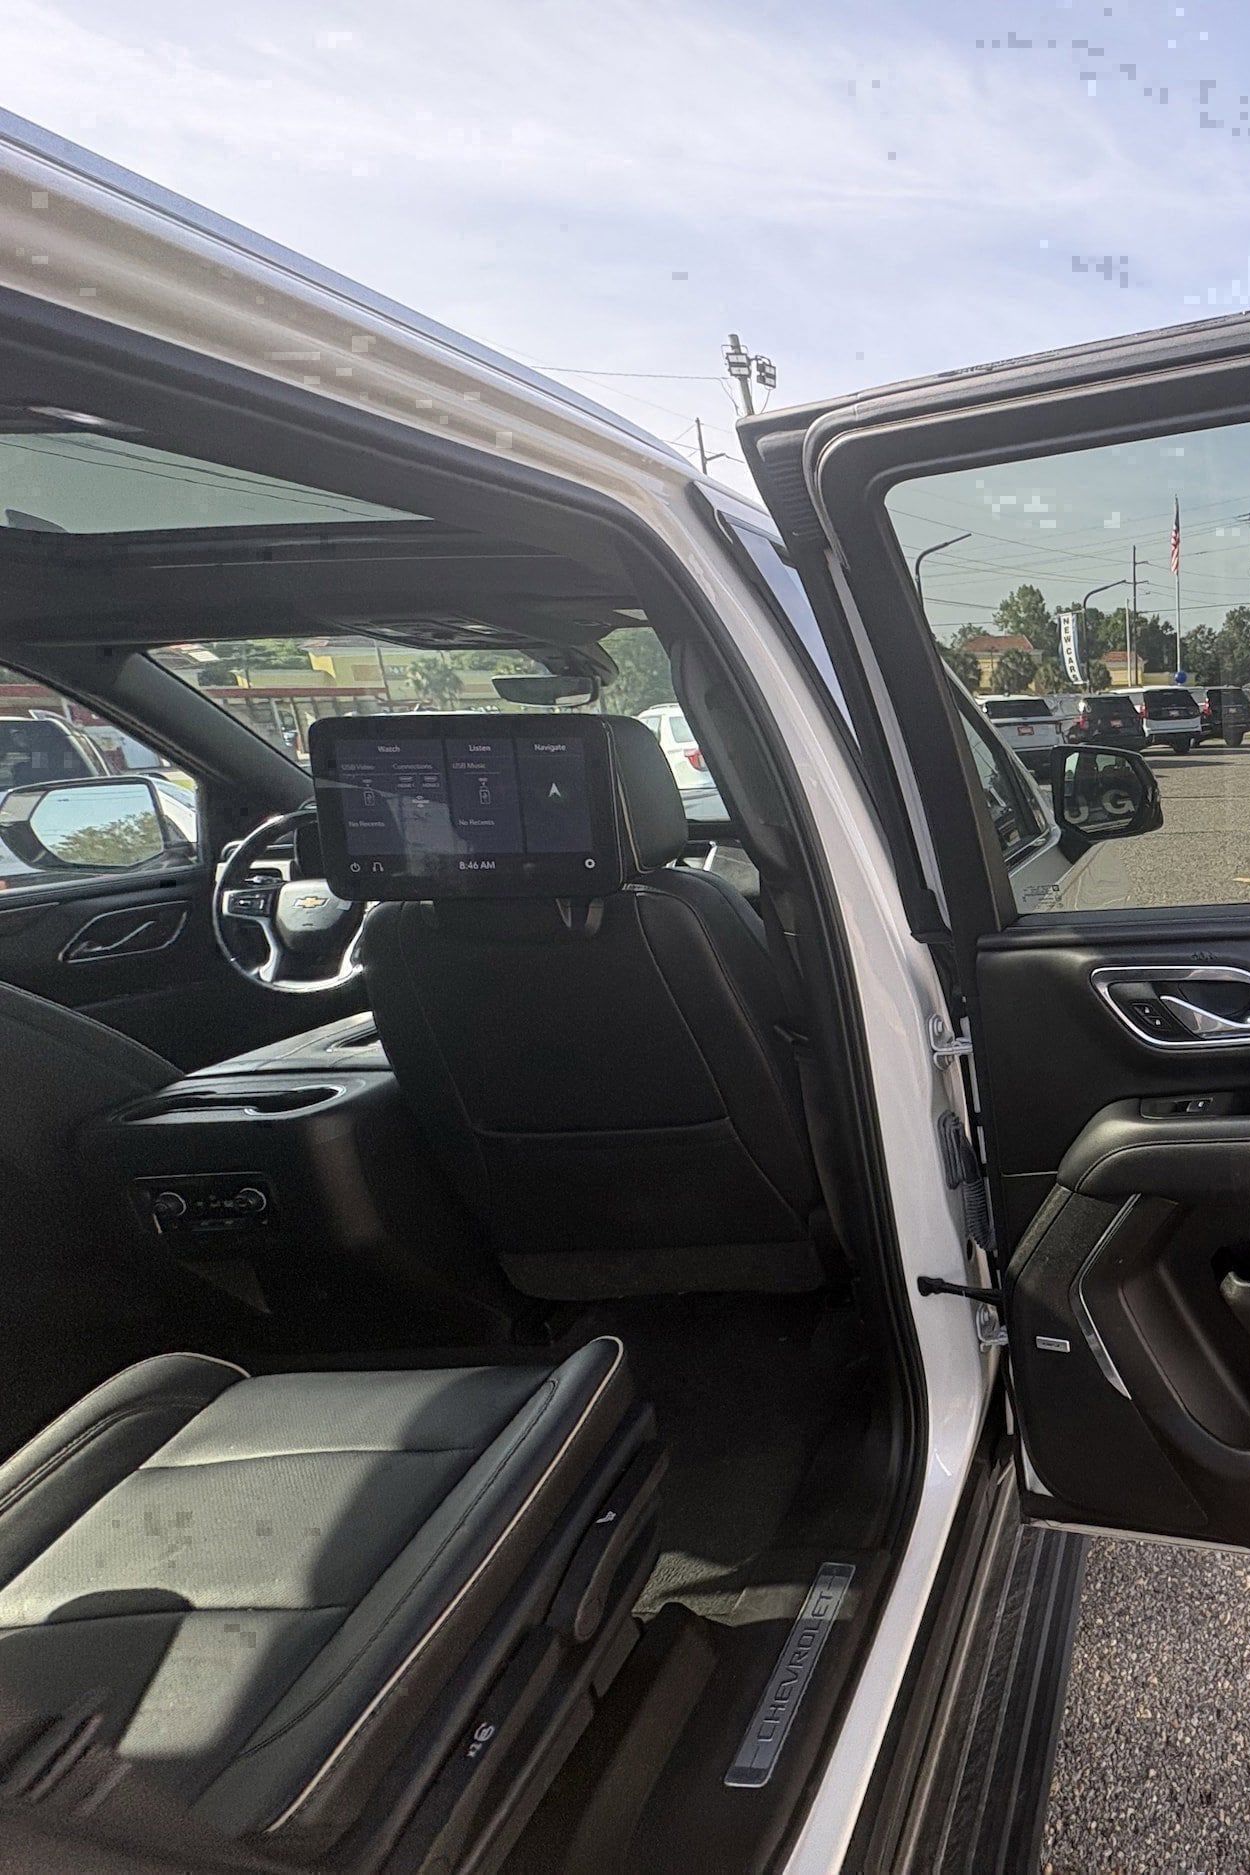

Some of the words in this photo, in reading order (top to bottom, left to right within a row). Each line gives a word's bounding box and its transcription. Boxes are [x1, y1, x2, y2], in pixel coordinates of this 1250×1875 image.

[1063, 617, 1071, 643] NEW
[1066, 647, 1079, 681] CARS
[377, 744, 401, 753] Watch
[468, 744, 492, 752] Listen
[533, 743, 567, 753] Navigate
[392, 763, 433, 771] Connections
[452, 762, 466, 770] USB
[467, 761, 487, 770] Music
[458, 819, 468, 827] No
[469, 818, 495, 827] Recents
[459, 860, 479, 870] 8:46
[480, 860, 496, 870] AM
[757, 1591, 833, 1742] CHEVROLET
